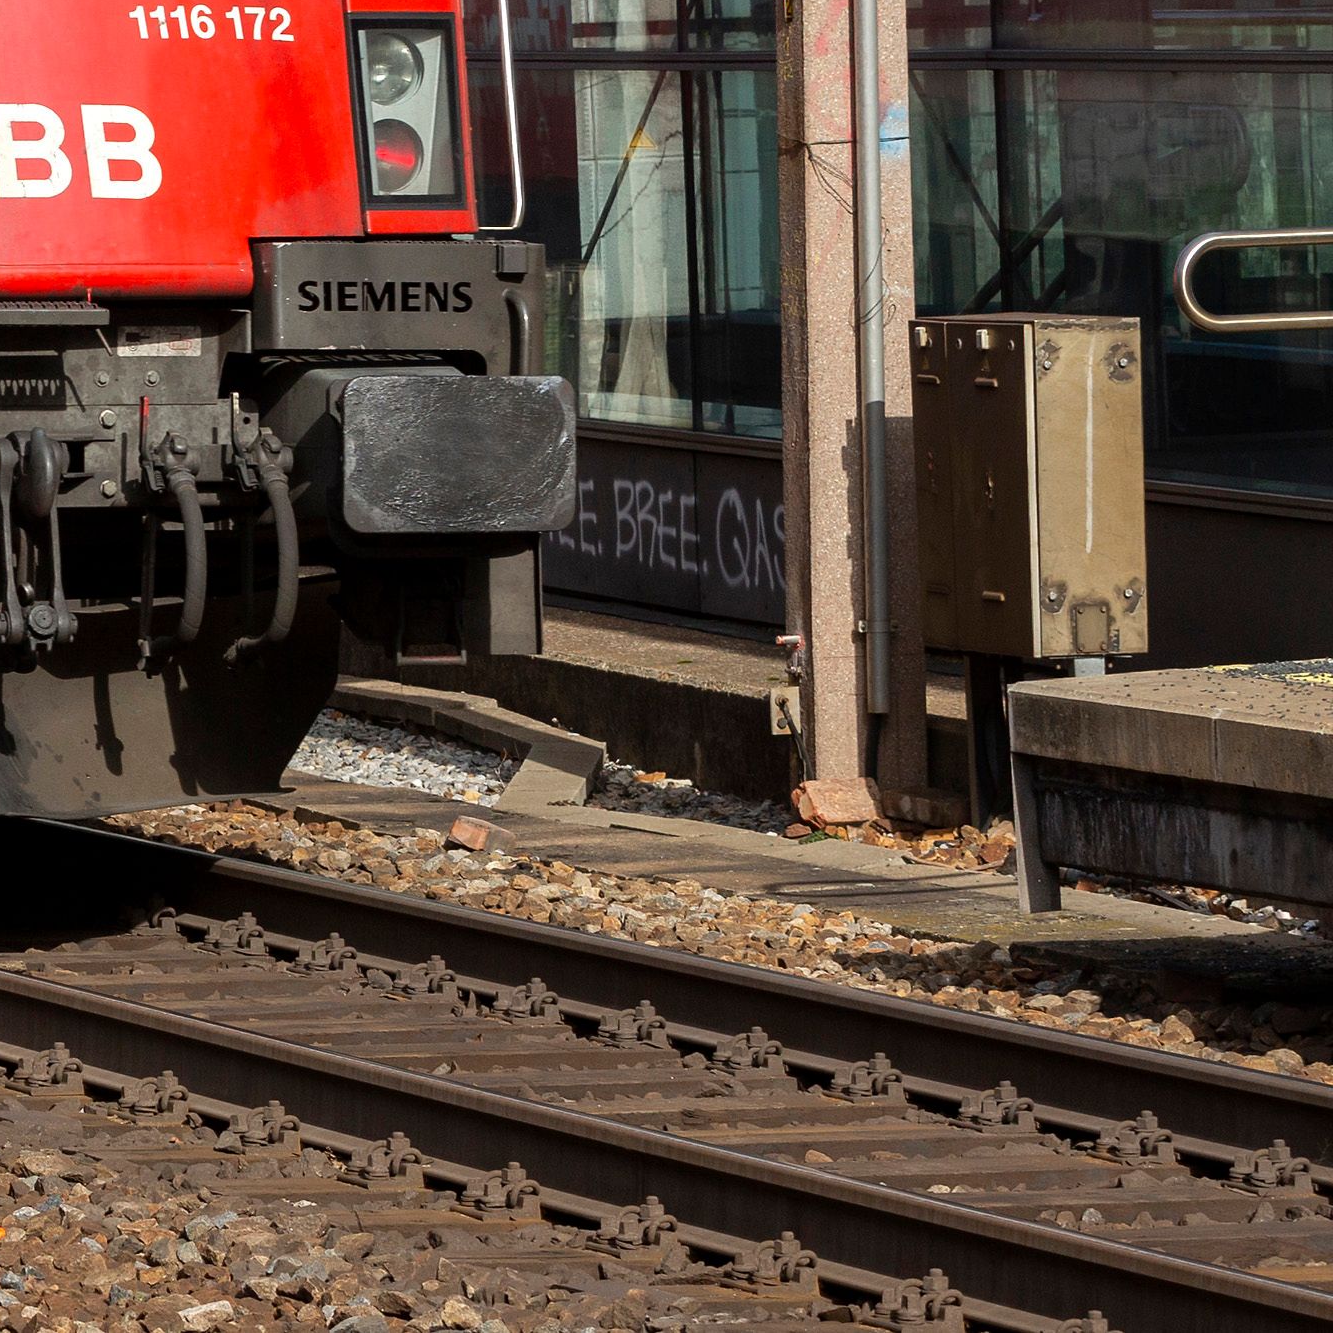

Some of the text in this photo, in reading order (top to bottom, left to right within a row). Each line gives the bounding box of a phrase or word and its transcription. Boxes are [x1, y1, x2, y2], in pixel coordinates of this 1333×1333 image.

[128, 4, 295, 42] 1116 172
[297, 280, 473, 313] SIEMENS
